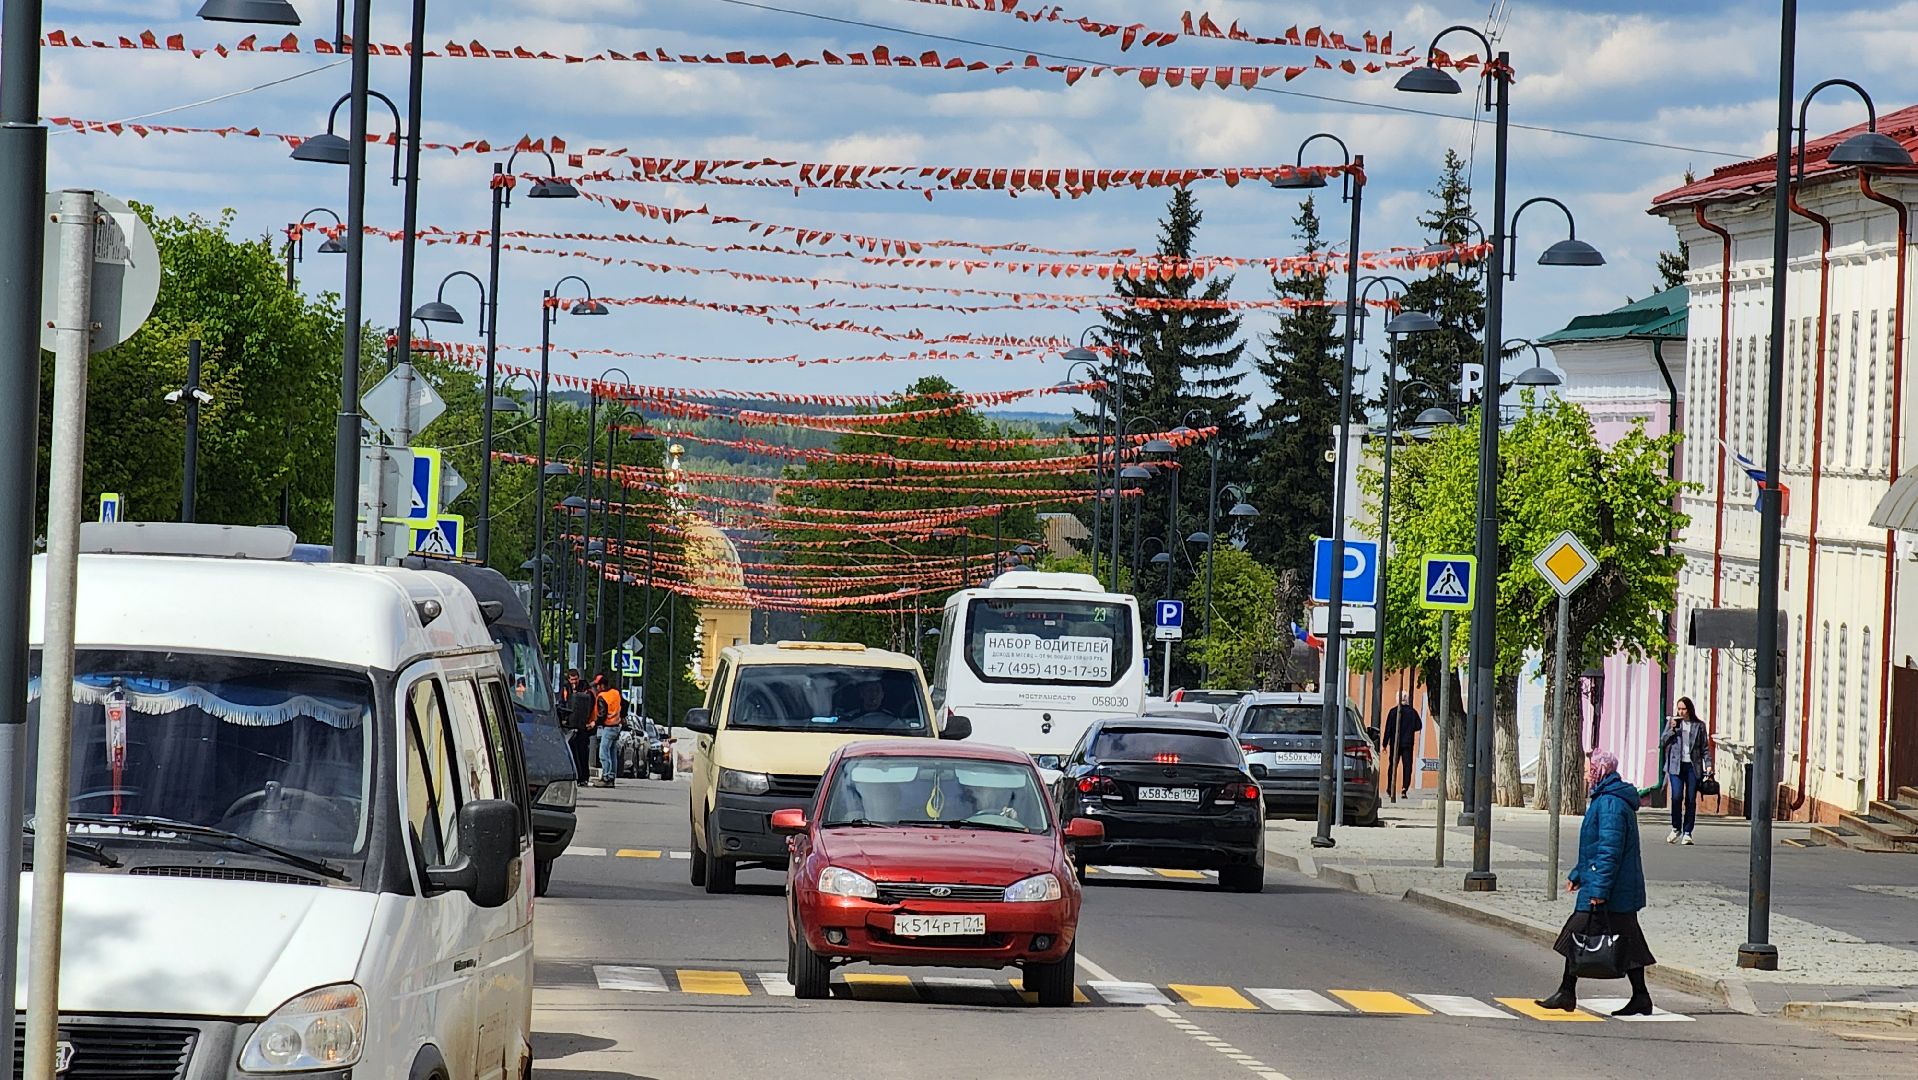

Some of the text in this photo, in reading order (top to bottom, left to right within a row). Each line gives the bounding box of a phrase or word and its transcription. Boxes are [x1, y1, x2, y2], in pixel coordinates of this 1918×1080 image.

[1094, 607, 1106, 621] 23
[1162, 603, 1178, 625] P
[989, 638, 1109, 653] НАБОР ВОДИТЕЛЕЙ
[988, 662, 1108, 678] +7 (495) 419-17-95
[1092, 696, 1129, 707] 058030
[1182, 789, 1197, 799] 197
[901, 917, 980, 933] К514РТ 71
